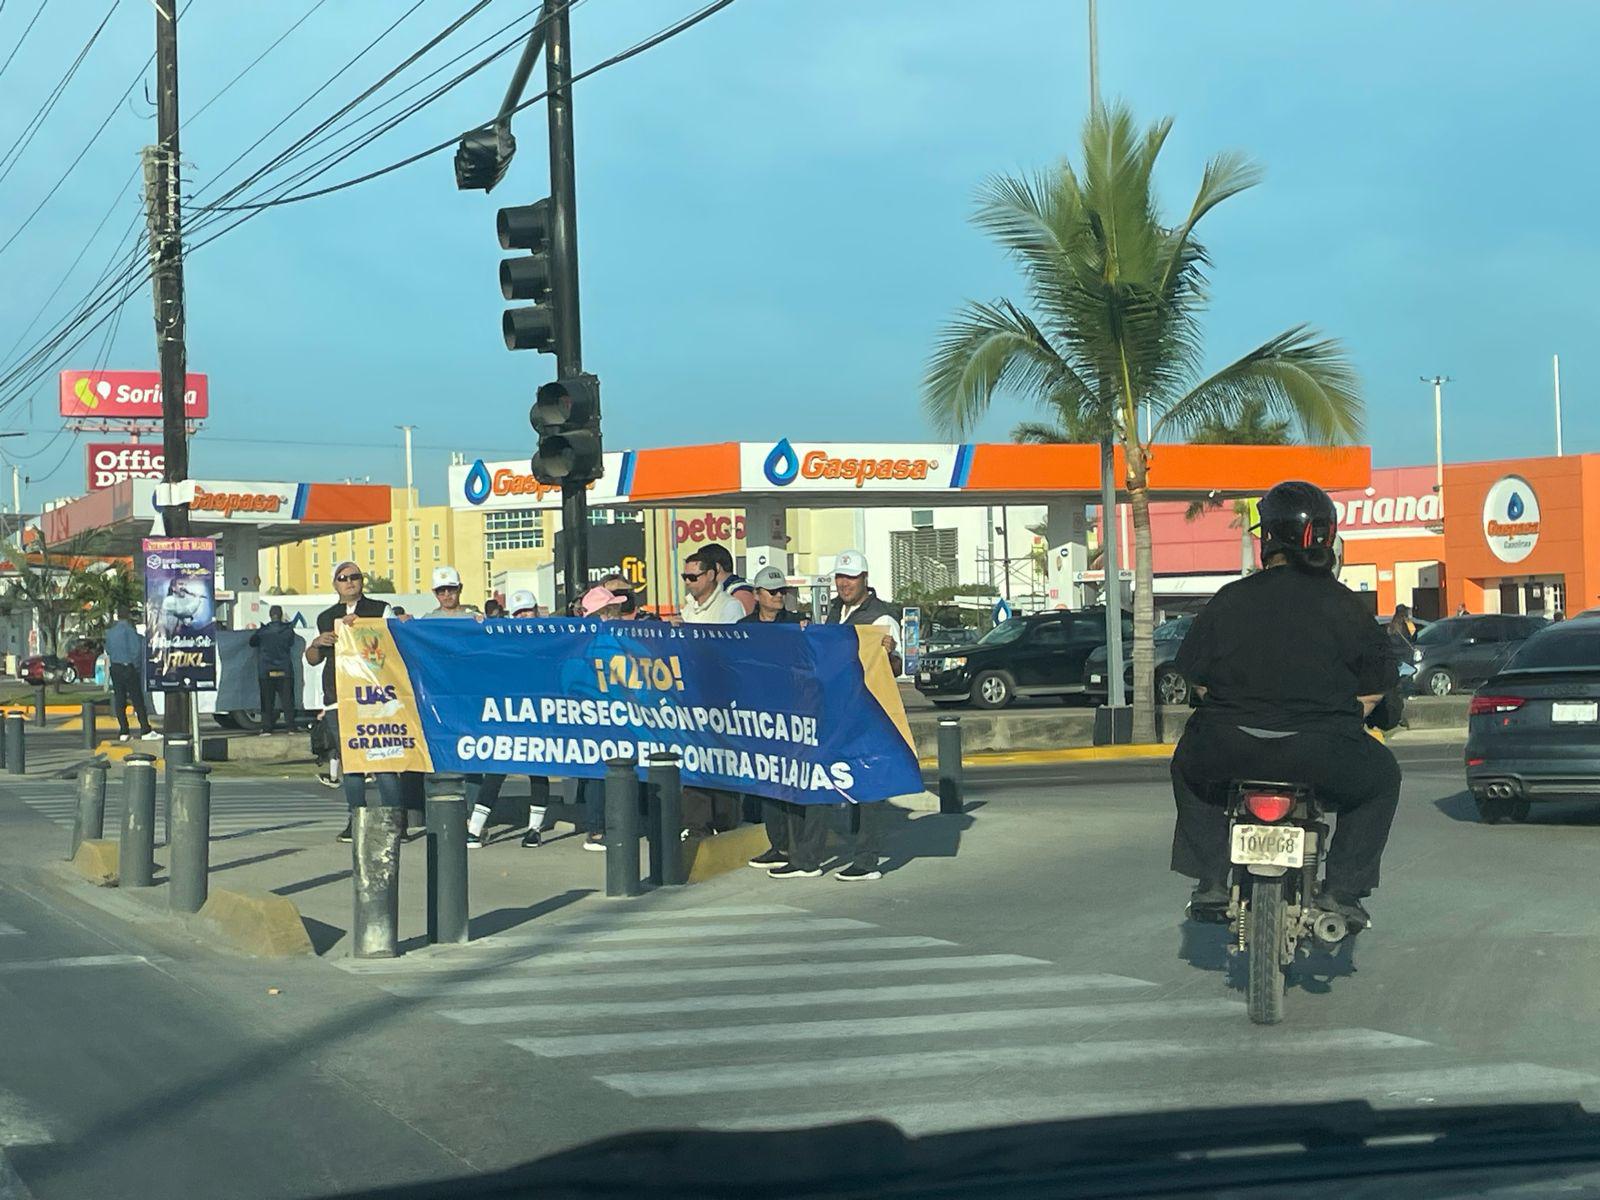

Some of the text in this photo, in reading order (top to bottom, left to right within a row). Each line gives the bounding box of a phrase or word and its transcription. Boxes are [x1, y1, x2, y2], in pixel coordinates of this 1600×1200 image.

[116, 384, 197, 405] Soria
[95, 450, 165, 470] Offic
[801, 450, 928, 488] Gaspasa
[1334, 487, 1444, 525] oriana
[588, 564, 621, 582] mart
[622, 556, 647, 584] fit
[670, 629, 685, 638] DE
[693, 629, 750, 639] SINALOA
[594, 655, 685, 693] ¡ALTO!
[355, 685, 397, 705] UAS
[356, 724, 407, 736] SOMOS
[481, 697, 819, 747] A LA PERSECUCIÓN POLÍTICA DEL
[348, 737, 415, 749] GRANDES
[457, 735, 634, 764] GOBERNADOR
[755, 753, 779, 783] DE
[781, 757, 799, 788] LA
[801, 761, 854, 791] UAS
